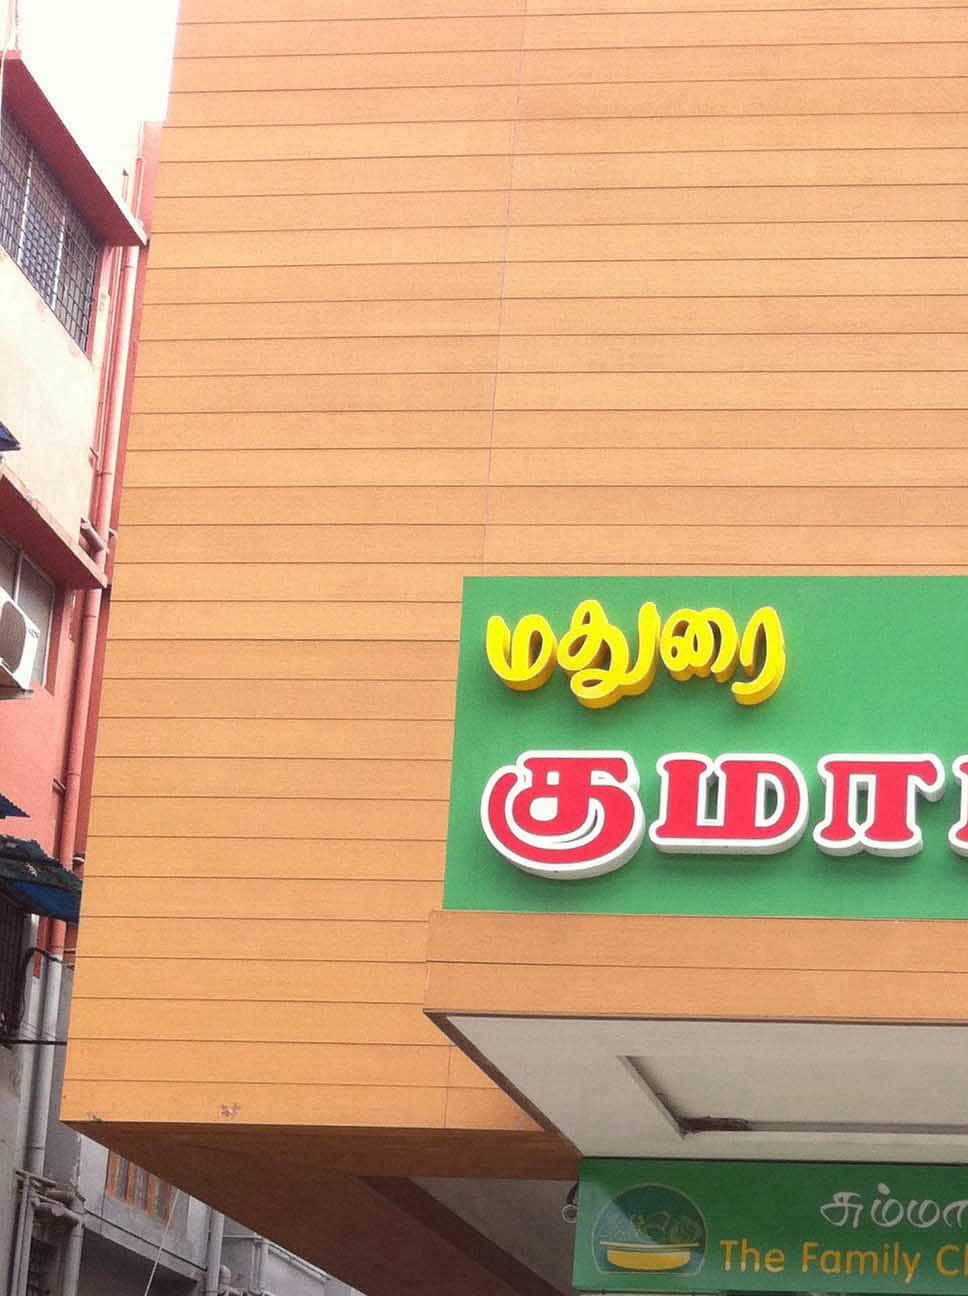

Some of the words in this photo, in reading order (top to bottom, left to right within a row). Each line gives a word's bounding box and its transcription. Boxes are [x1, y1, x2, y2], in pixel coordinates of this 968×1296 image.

[485, 600, 787, 709] மதுரை
[719, 1238, 785, 1273] The
[801, 1241, 920, 1284] Family
